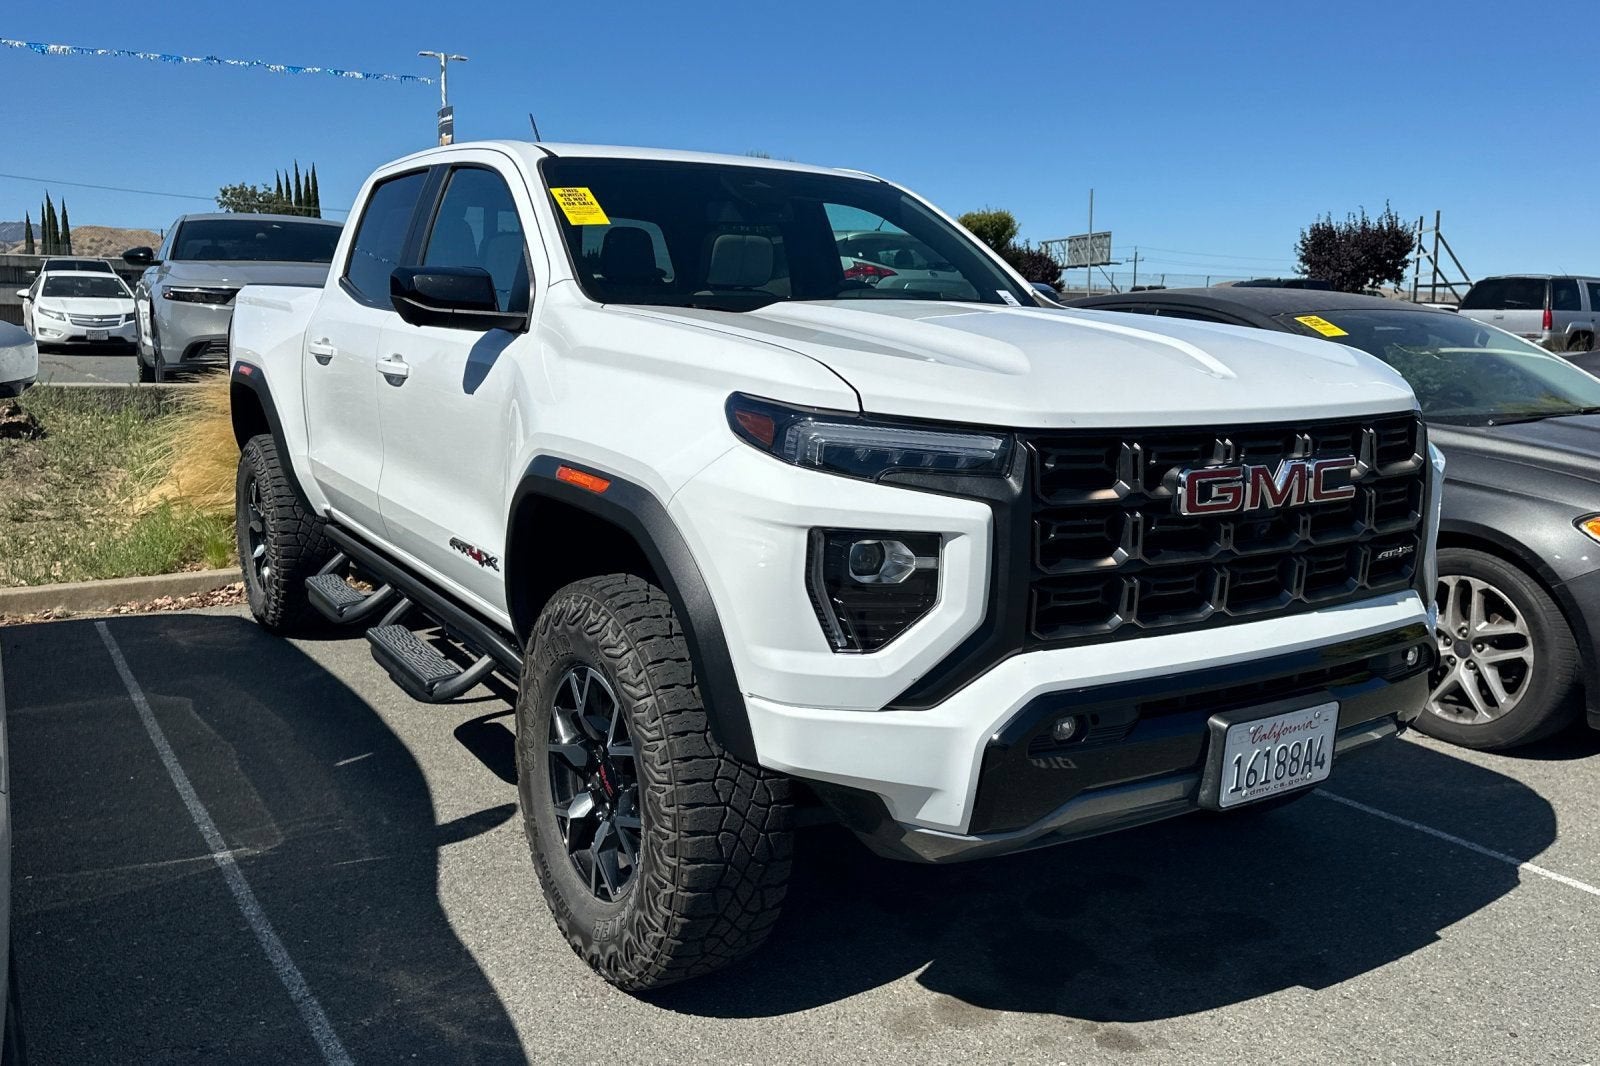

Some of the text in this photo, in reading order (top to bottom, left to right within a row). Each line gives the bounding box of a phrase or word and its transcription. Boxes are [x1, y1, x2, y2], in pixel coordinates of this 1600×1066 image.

[1177, 457, 1356, 516] GMC
[449, 536, 499, 572] AT4X
[1250, 718, 1319, 744] California
[1229, 734, 1325, 794] 16188A4
[1249, 776, 1307, 796] dmv.ca.gov
